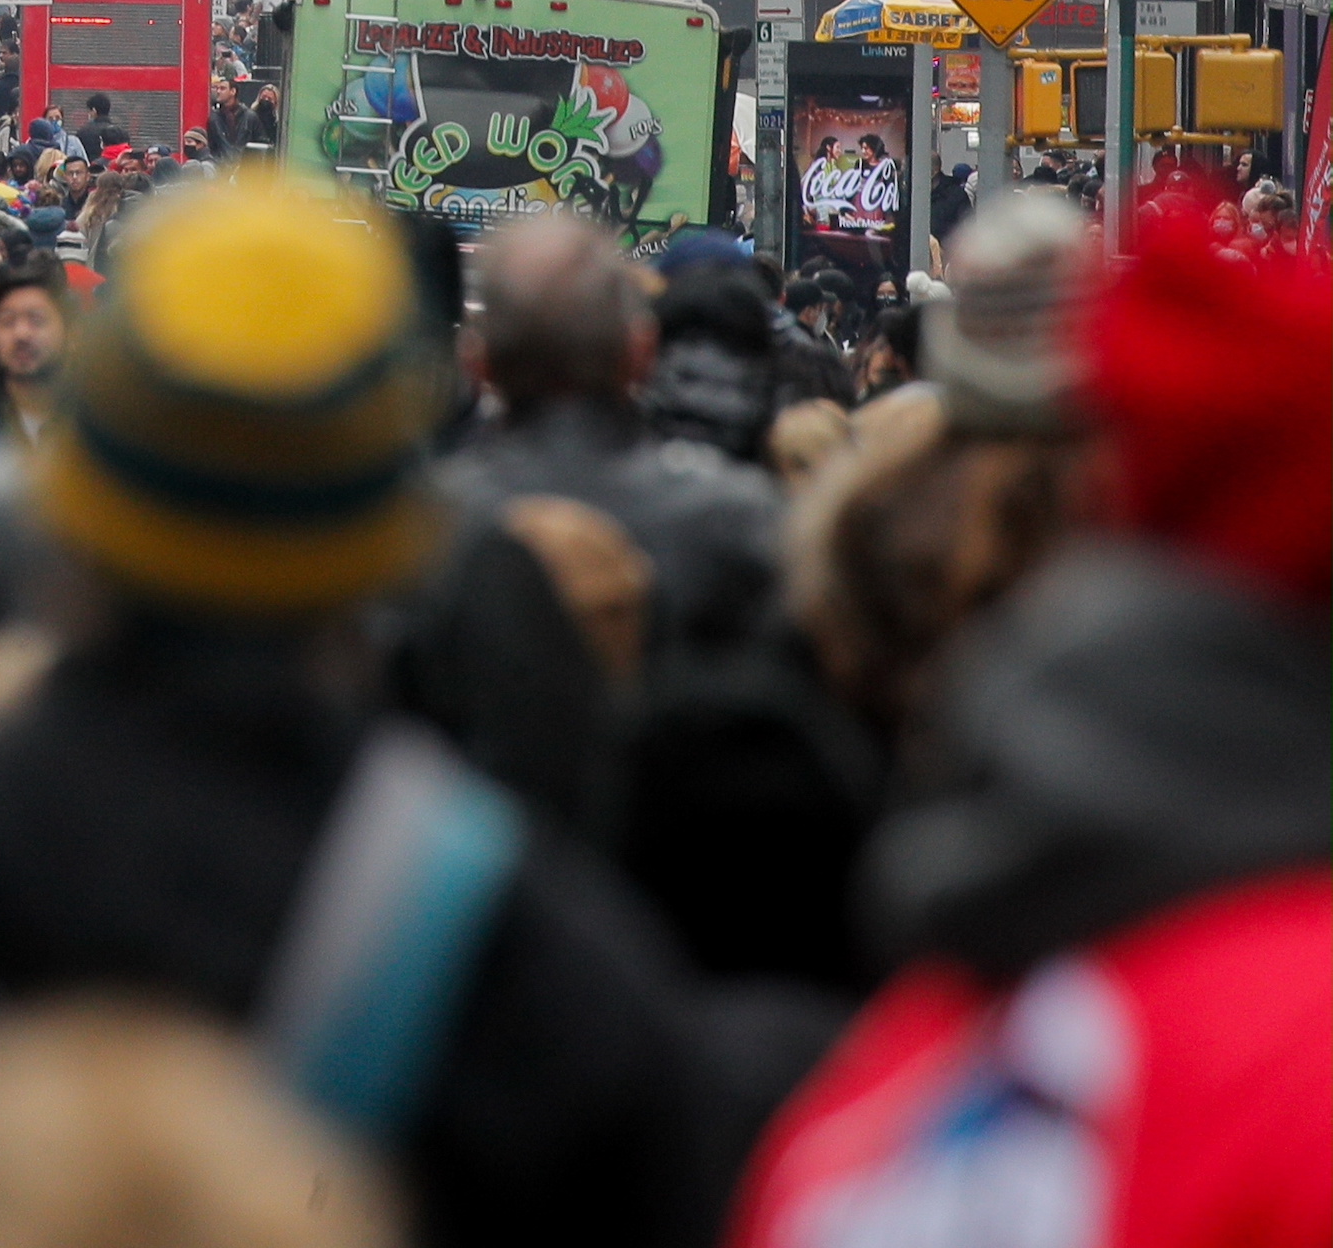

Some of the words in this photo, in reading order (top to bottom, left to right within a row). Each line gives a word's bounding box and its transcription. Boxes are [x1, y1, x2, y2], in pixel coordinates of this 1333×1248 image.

[759, 23, 770, 40] 6
[861, 46, 907, 57] LinkNYC
[629, 118, 665, 141] POPS
